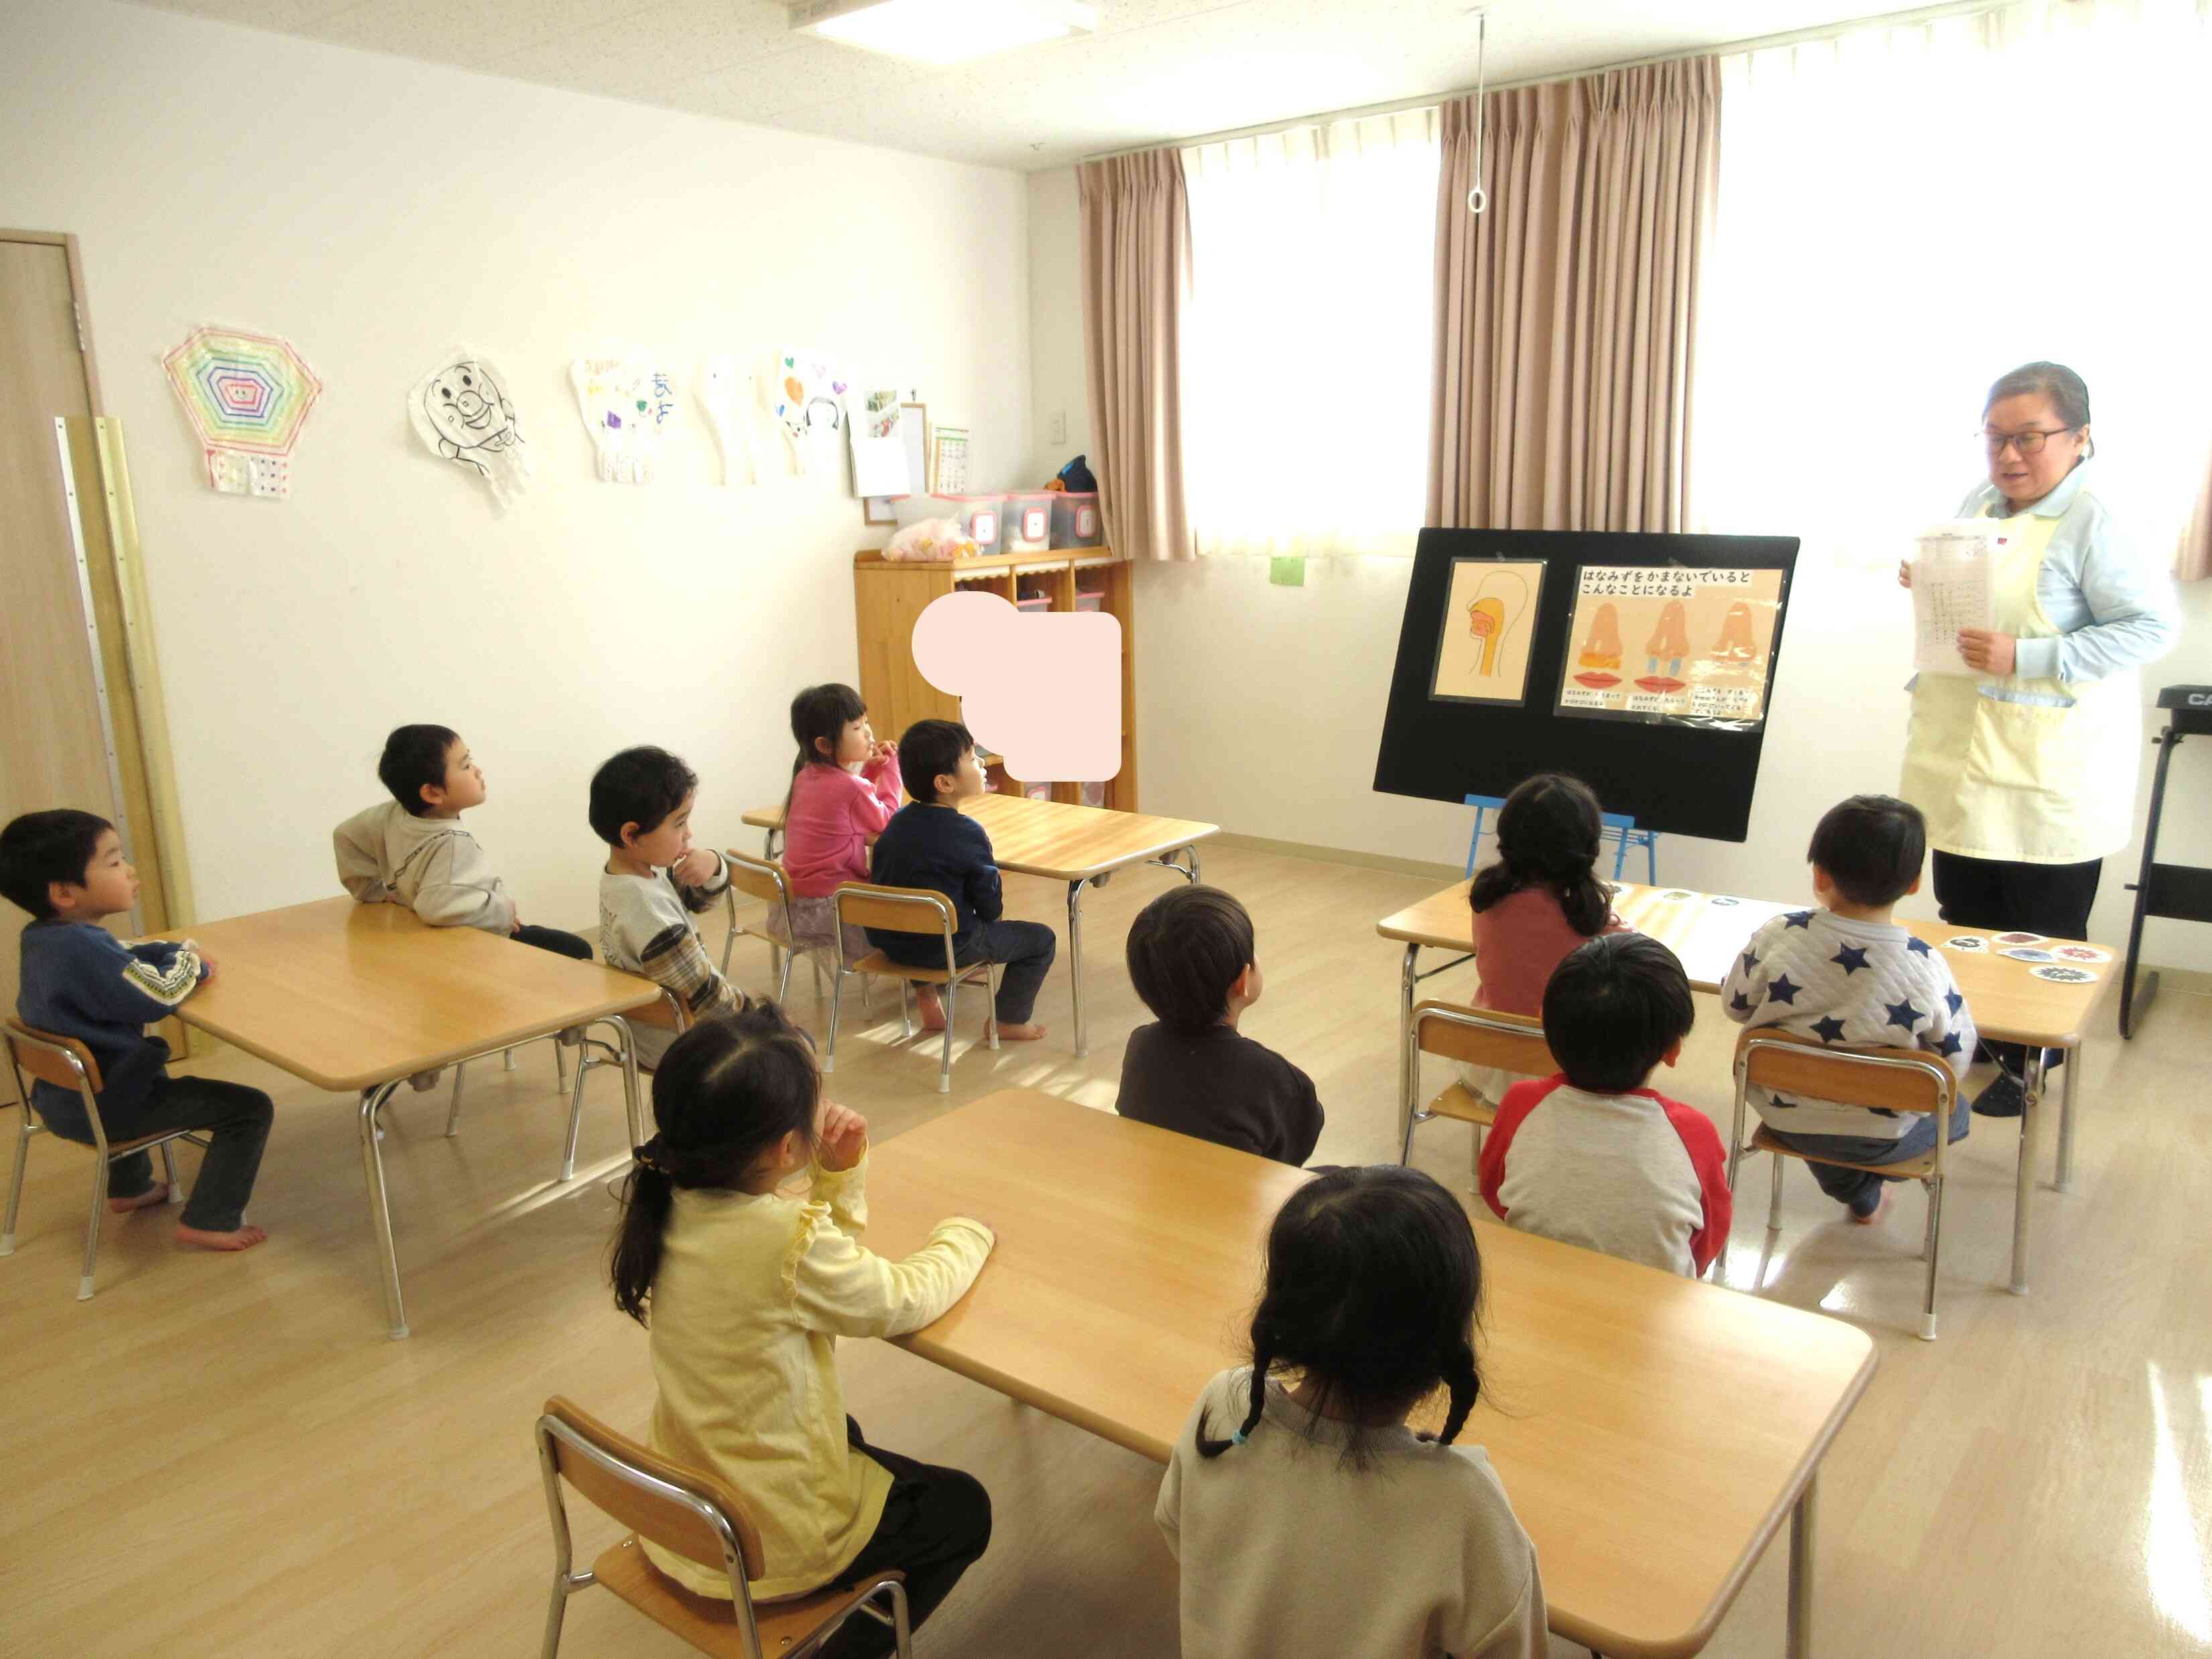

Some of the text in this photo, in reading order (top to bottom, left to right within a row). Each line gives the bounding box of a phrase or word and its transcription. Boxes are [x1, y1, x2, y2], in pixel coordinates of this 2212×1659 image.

[1583, 570, 1750, 583] はなみずをかまないでいると
[1582, 583, 1693, 597] こんなことになるよ
